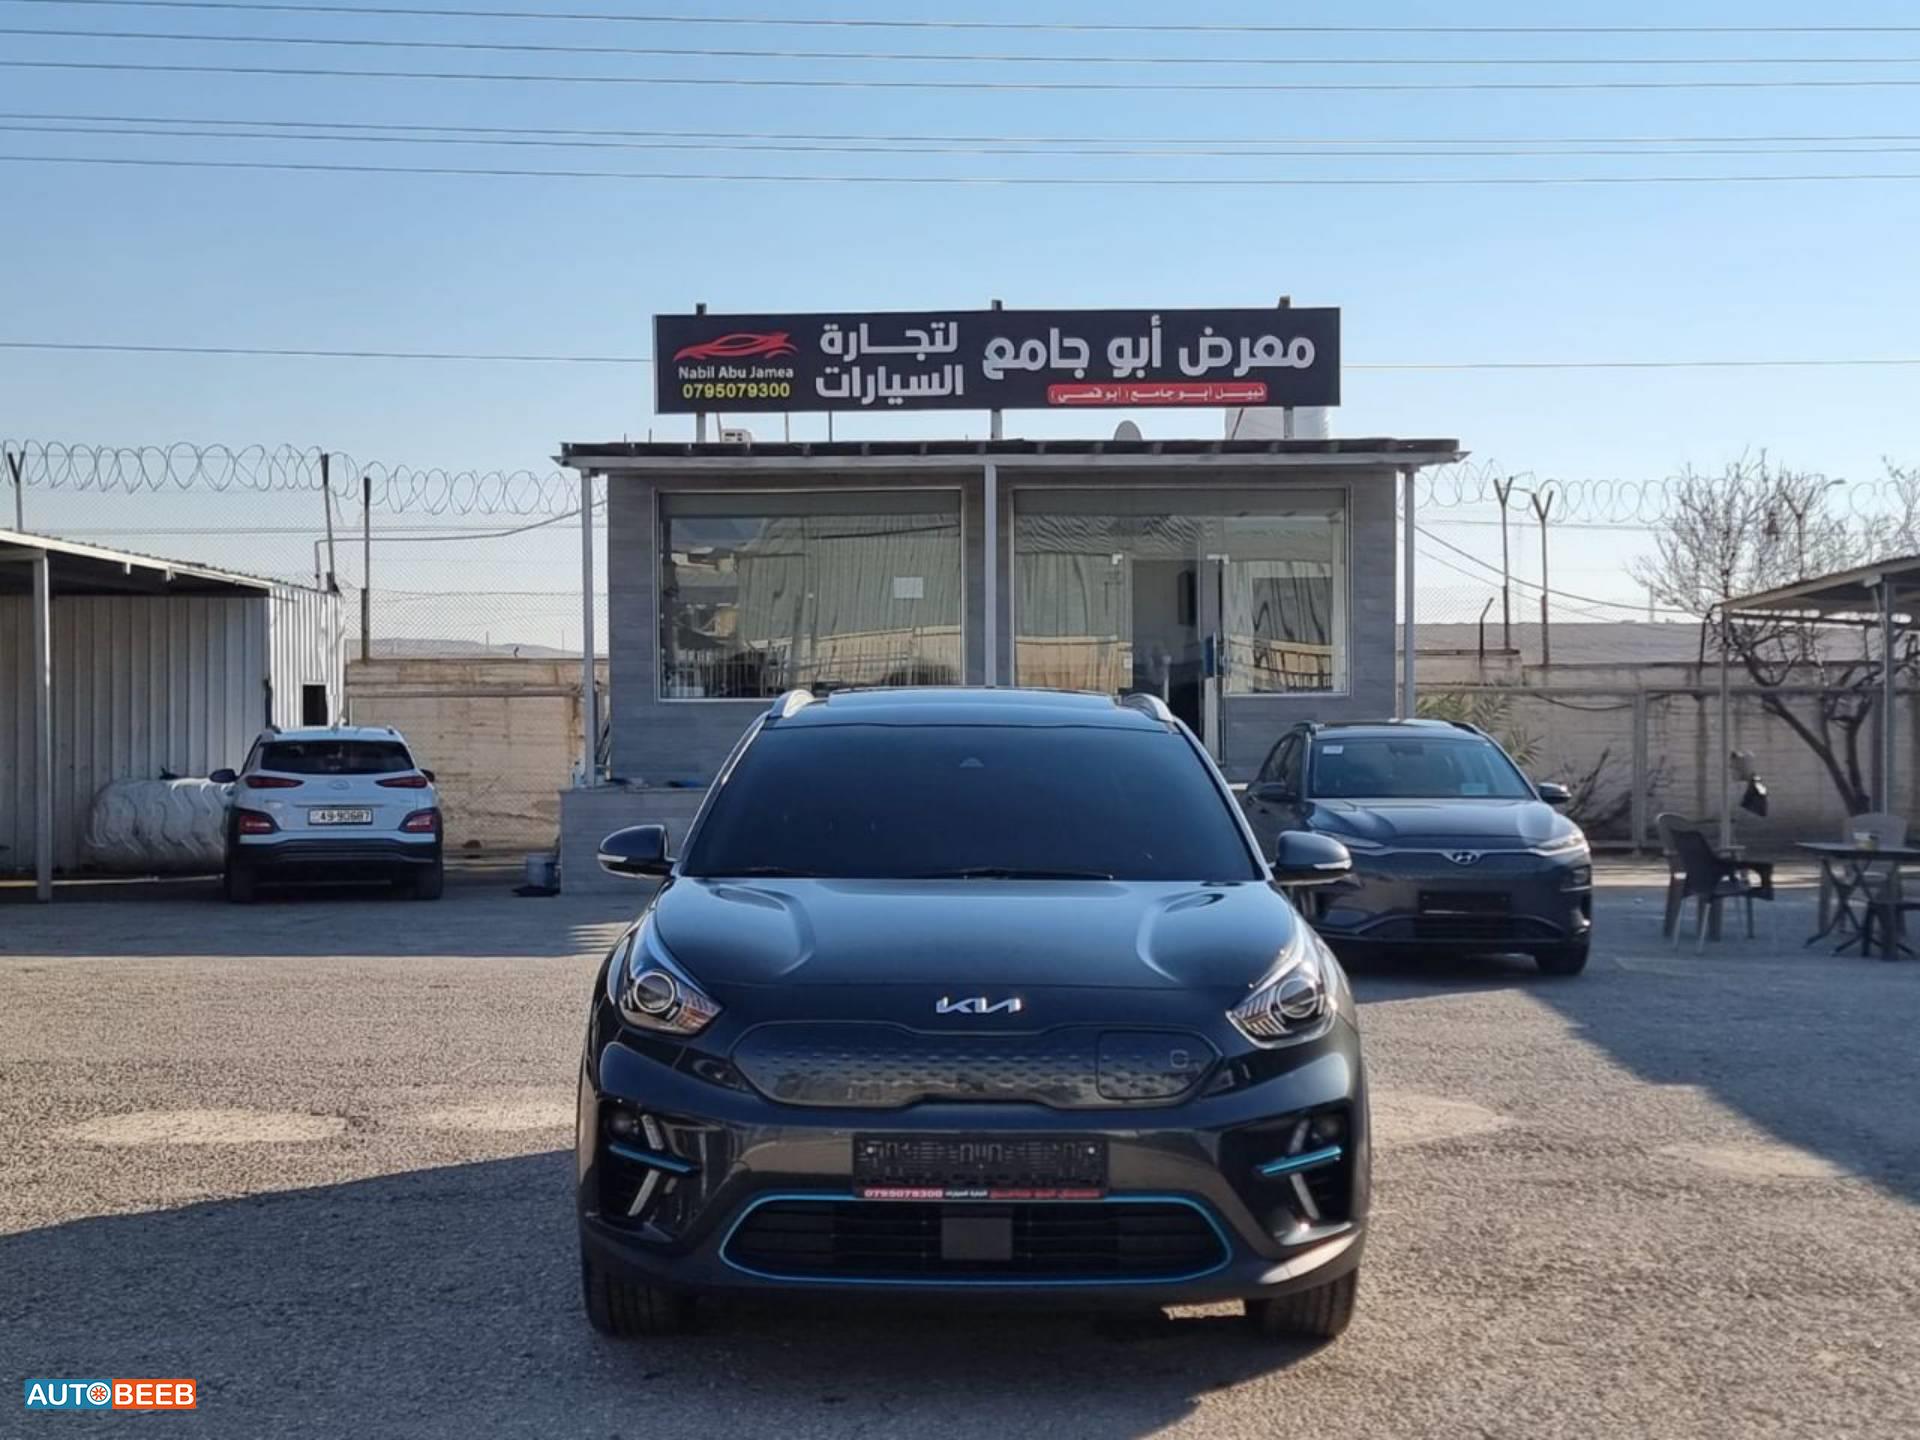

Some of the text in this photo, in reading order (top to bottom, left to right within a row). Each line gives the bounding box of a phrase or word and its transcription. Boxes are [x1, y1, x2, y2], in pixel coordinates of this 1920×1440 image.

[819, 321, 958, 362] لتجارة
[982, 313, 1315, 380] معرض أبو جامع
[678, 365, 794, 379] Nabil Abu Jamea
[815, 364, 964, 405] السيارات
[682, 382, 790, 399] 0795079300
[936, 996, 1022, 1013] KIA
